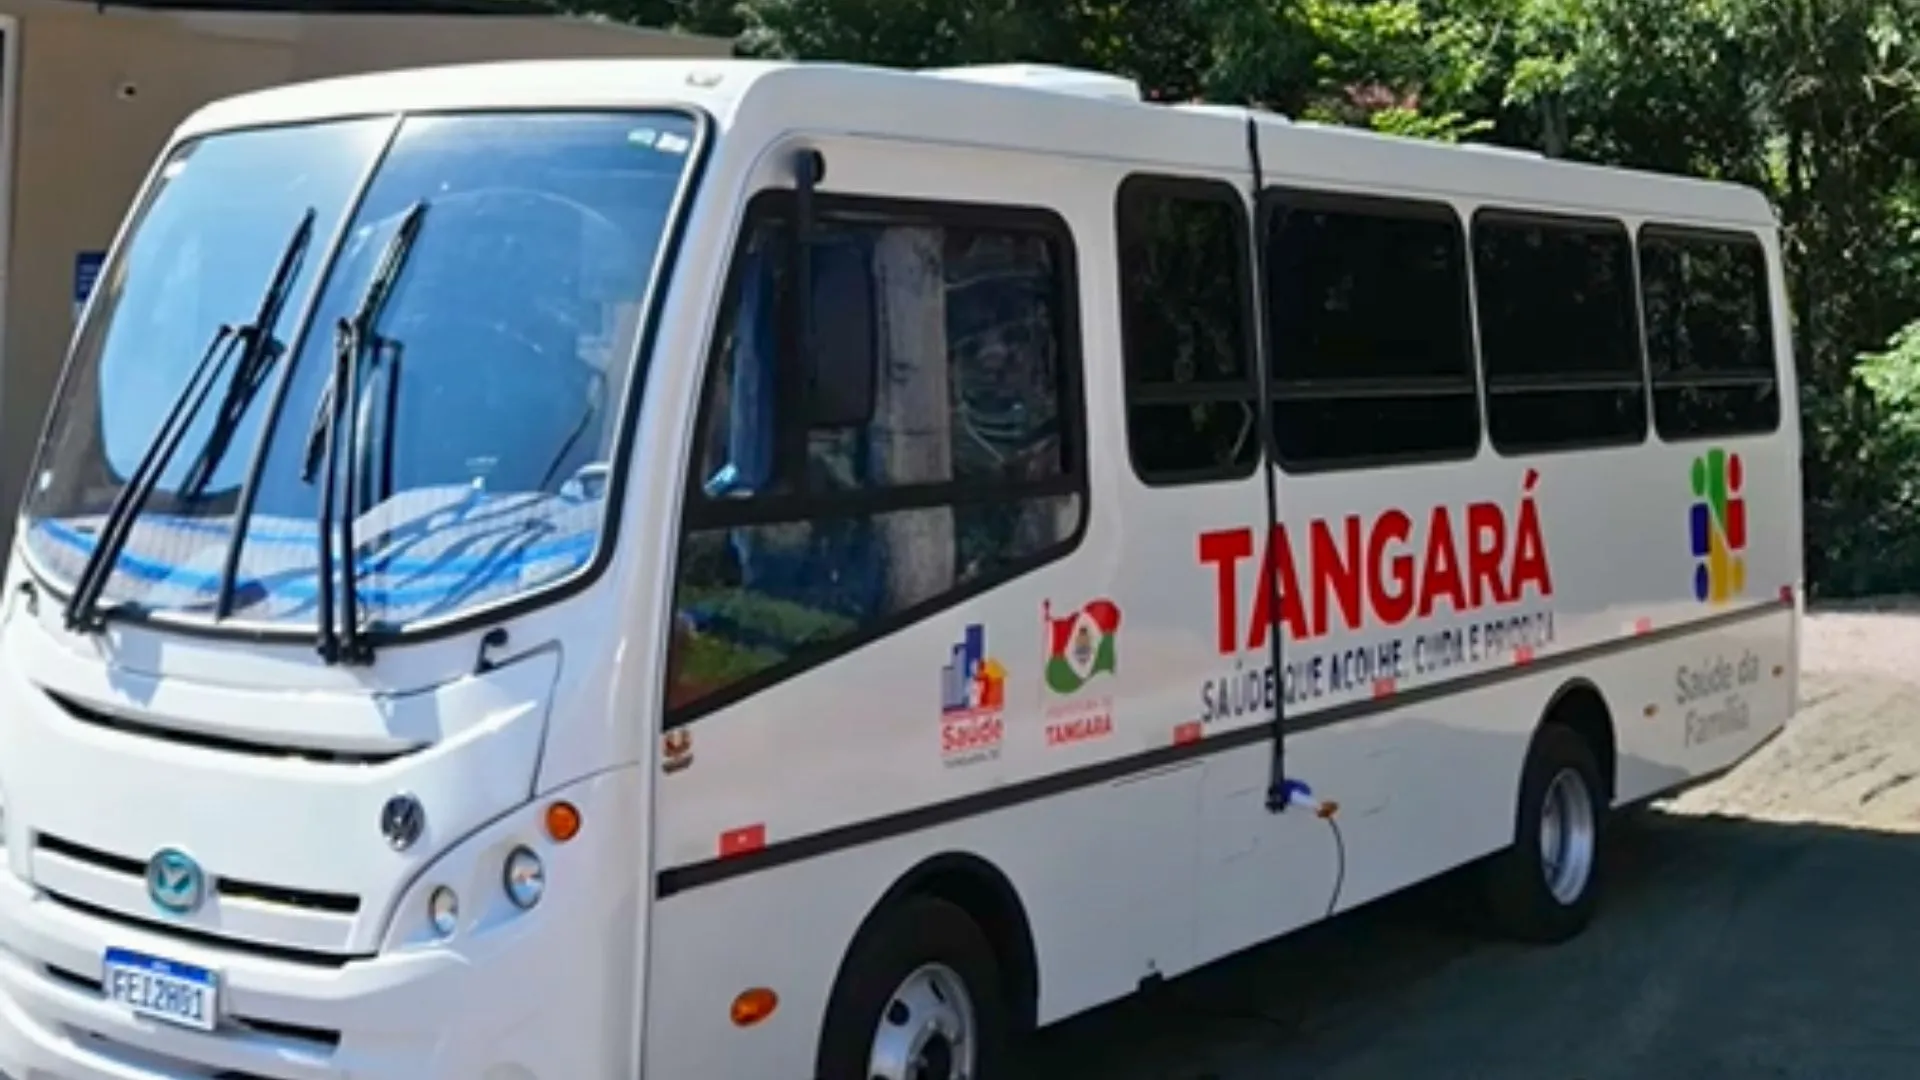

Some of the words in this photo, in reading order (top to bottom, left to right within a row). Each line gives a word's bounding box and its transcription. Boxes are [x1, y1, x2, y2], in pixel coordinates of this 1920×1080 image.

[1199, 468, 1553, 655] TANGARÁ
[1203, 660, 1275, 722] SAÚDE
[1284, 655, 1323, 704] QUE
[1470, 624, 1480, 661] E
